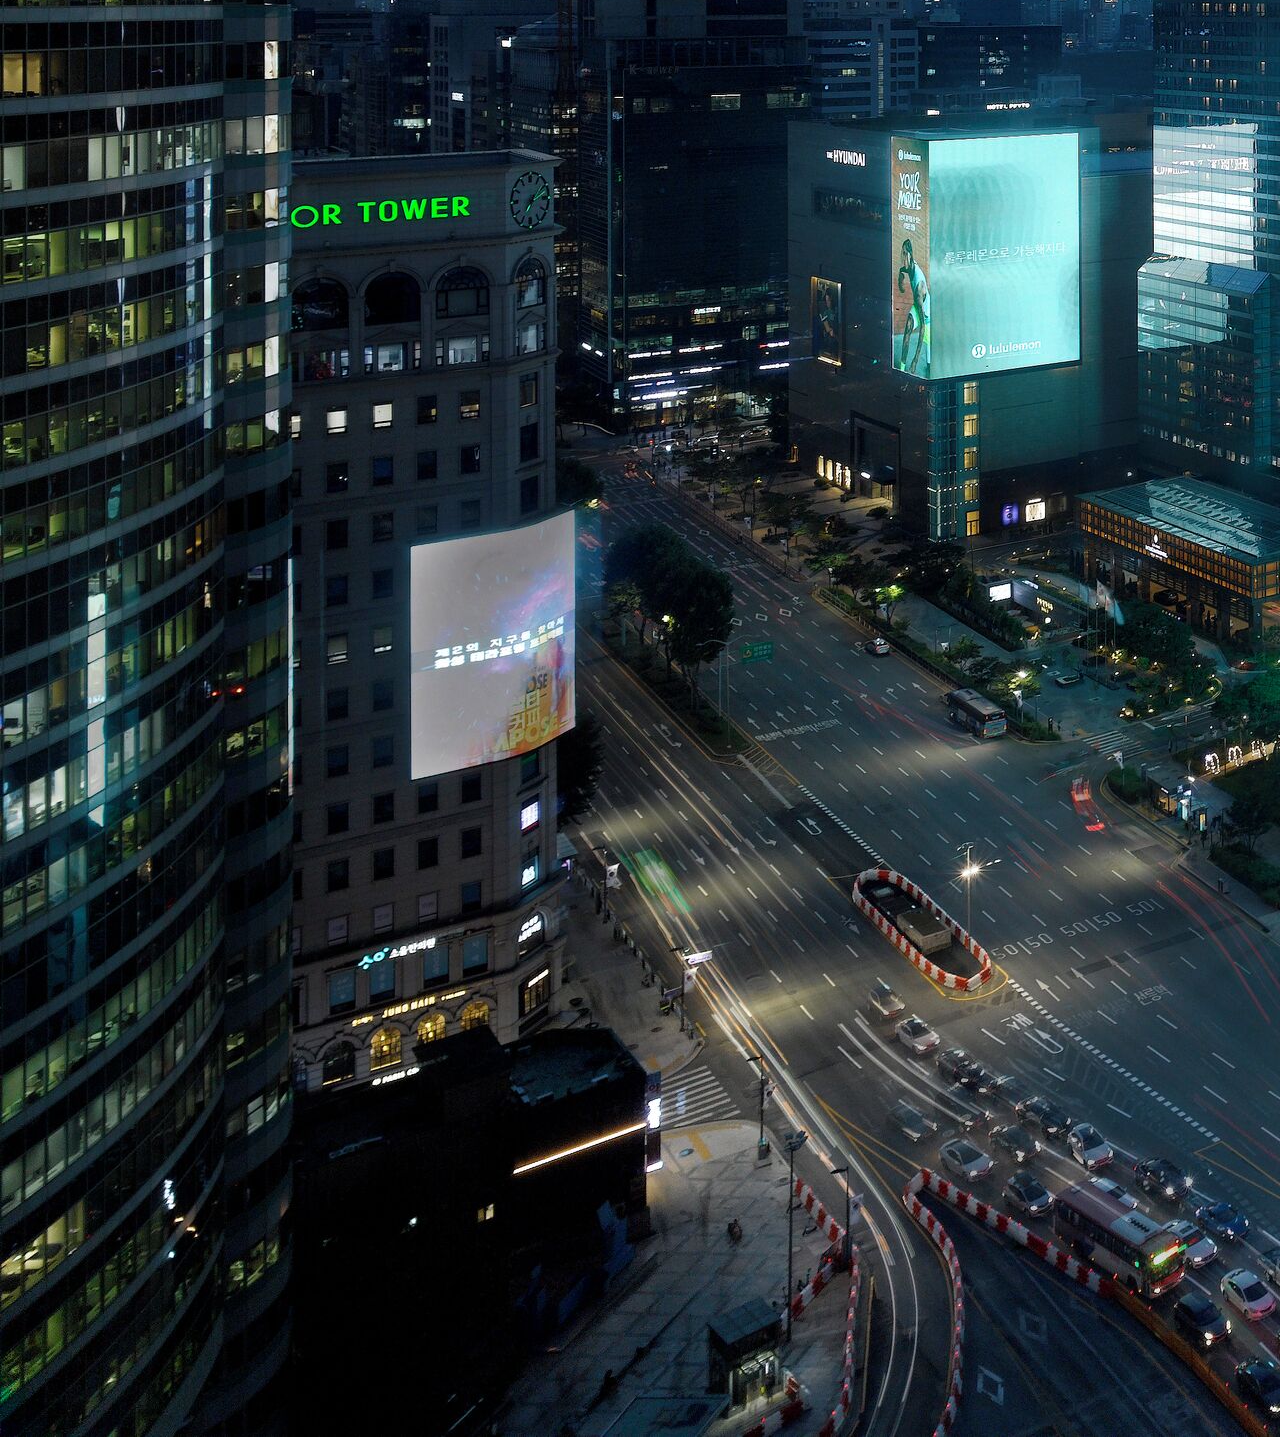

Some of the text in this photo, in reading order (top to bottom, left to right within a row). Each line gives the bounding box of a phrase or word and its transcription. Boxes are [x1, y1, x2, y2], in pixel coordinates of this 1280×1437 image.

[833, 149, 866, 167] HYUNDAI
[899, 171, 920, 194] YOUR
[358, 194, 471, 224] TOWER
[897, 190, 922, 210] MOVE
[944, 242, 1066, 265] 룰루레몬으로 가능해지다
[989, 340, 1041, 355] lululemon
[434, 642, 479, 658] 제2의
[490, 630, 531, 648] 지구를
[470, 642, 526, 663] 테라포밍
[990, 900, 1155, 960] 50 50 50 50 50
[382, 1004, 409, 1019] JUNO
[411, 996, 436, 1010] HAIR
[382, 1070, 406, 1084] PARIS
